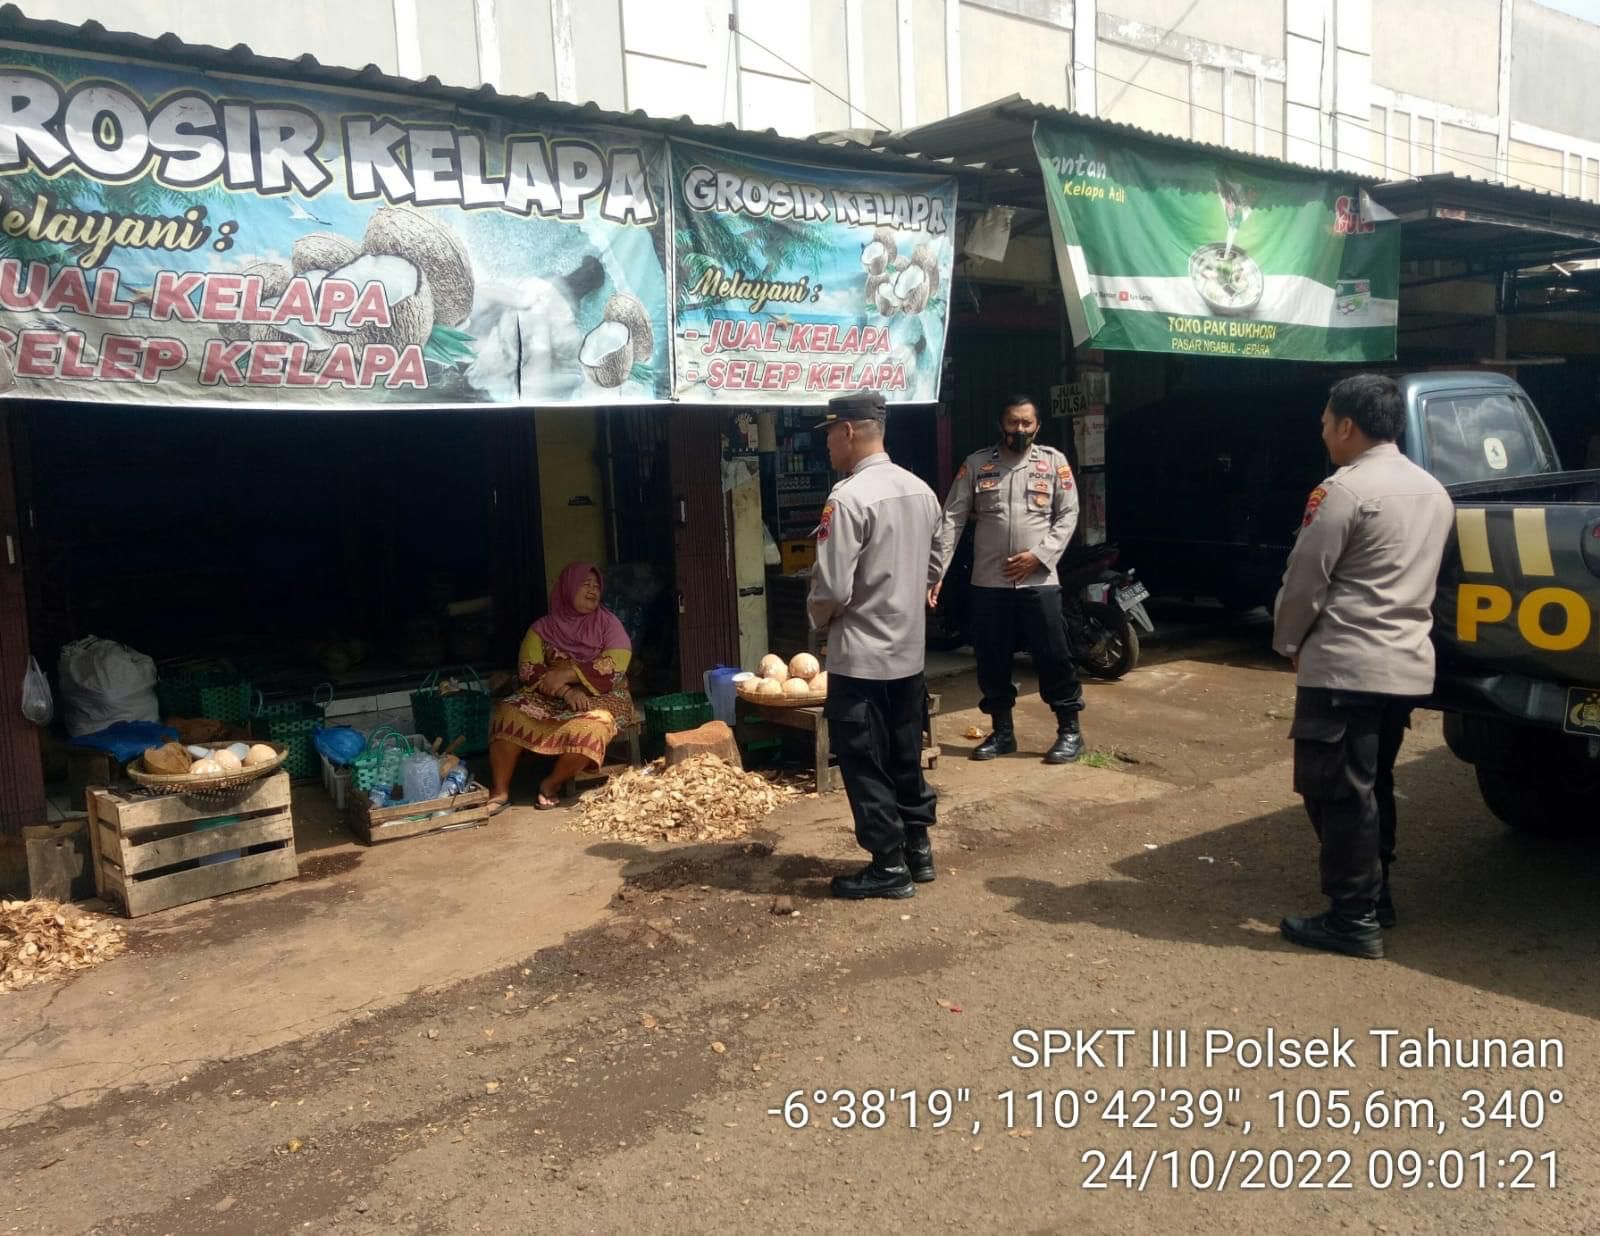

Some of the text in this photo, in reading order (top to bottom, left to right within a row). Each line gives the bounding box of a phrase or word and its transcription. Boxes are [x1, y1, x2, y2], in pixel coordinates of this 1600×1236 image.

[343, 116, 656, 225] KELAPA
[683, 165, 947, 234] GROSIR KELAPA
[1063, 180, 1104, 202] Kelapa
[149, 271, 392, 327] KELAPA
[690, 266, 808, 314] Melayani
[701, 320, 781, 354] JUAL
[788, 323, 891, 353] KELAPA
[1168, 317, 1277, 339] TOKO PAK BUKHORI
[0, 325, 430, 389] ELEP KELAPA
[1171, 338, 1202, 351] PASAR
[1203, 341, 1237, 354] NGABUL
[706, 360, 802, 389] SELEP
[806, 363, 906, 391] KELAPA
[1057, 383, 1081, 397] JUAL
[1052, 395, 1088, 415] PULSA
